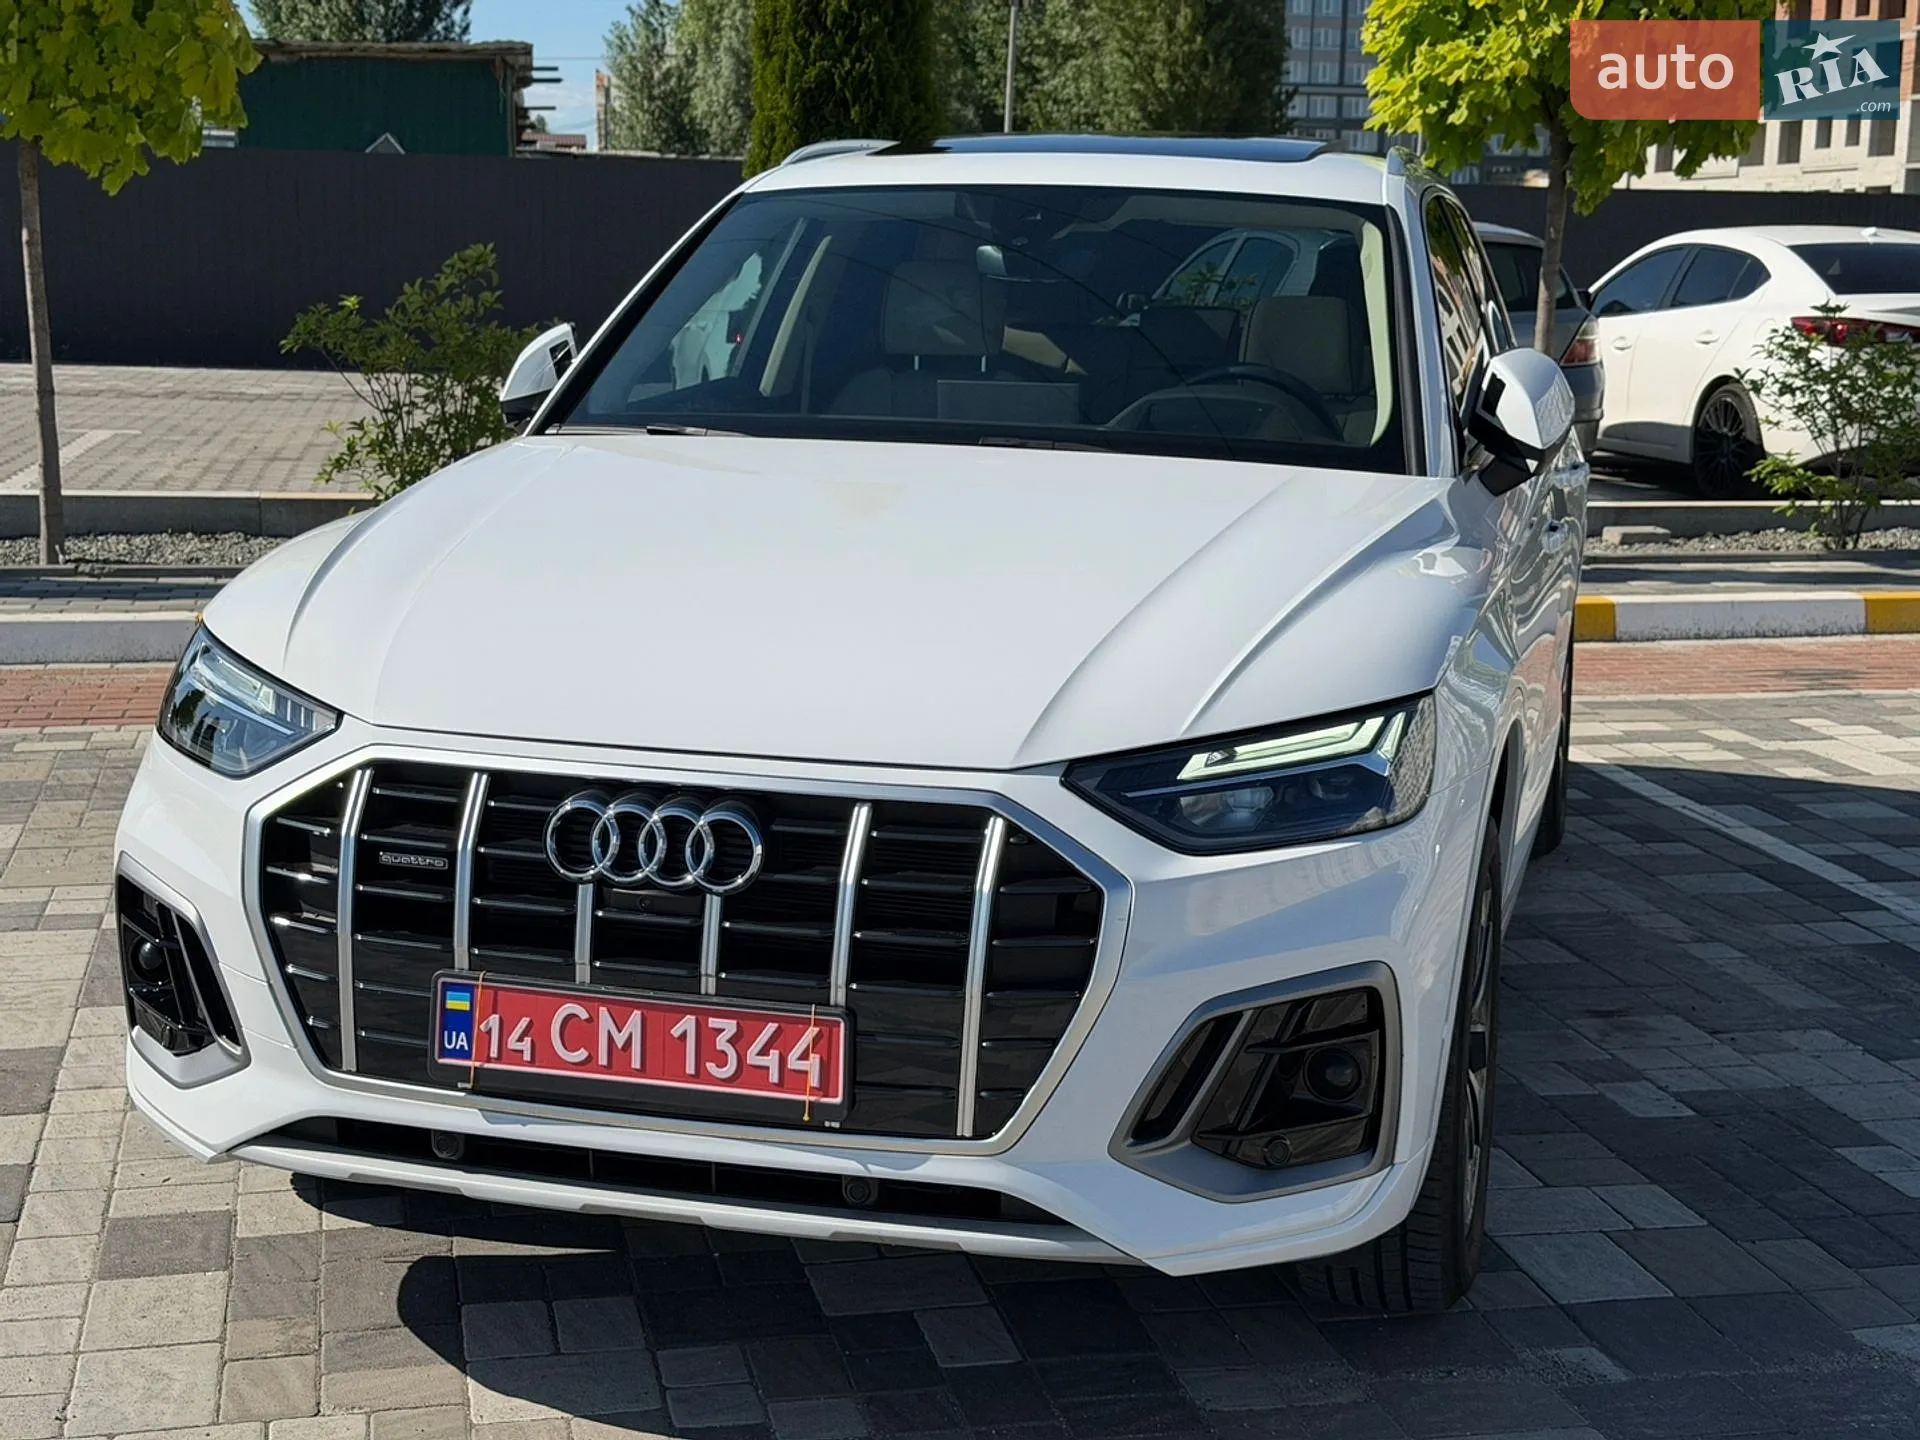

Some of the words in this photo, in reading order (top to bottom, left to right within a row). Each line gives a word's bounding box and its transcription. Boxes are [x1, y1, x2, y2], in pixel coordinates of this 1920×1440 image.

[381, 854, 444, 867] quattro
[443, 1030, 469, 1052] UA
[479, 1014, 532, 1062] 14
[550, 1003, 643, 1070] CM
[670, 1014, 821, 1088] 1344
